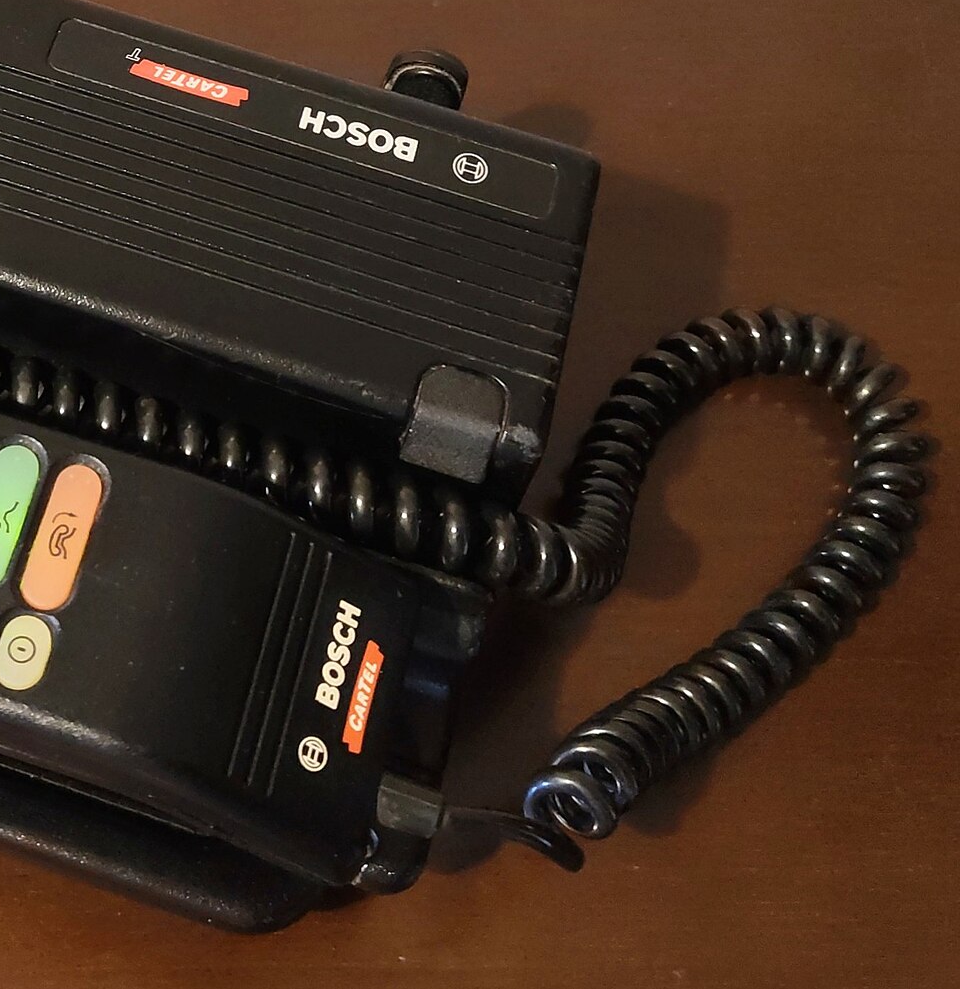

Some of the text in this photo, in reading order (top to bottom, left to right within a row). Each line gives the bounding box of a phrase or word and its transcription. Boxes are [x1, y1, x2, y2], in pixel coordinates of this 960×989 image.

[154, 65, 229, 98] CARTEL
[298, 106, 419, 163] BOSCH
[315, 600, 362, 710] BOSCH
[349, 662, 377, 732] CARTEL
